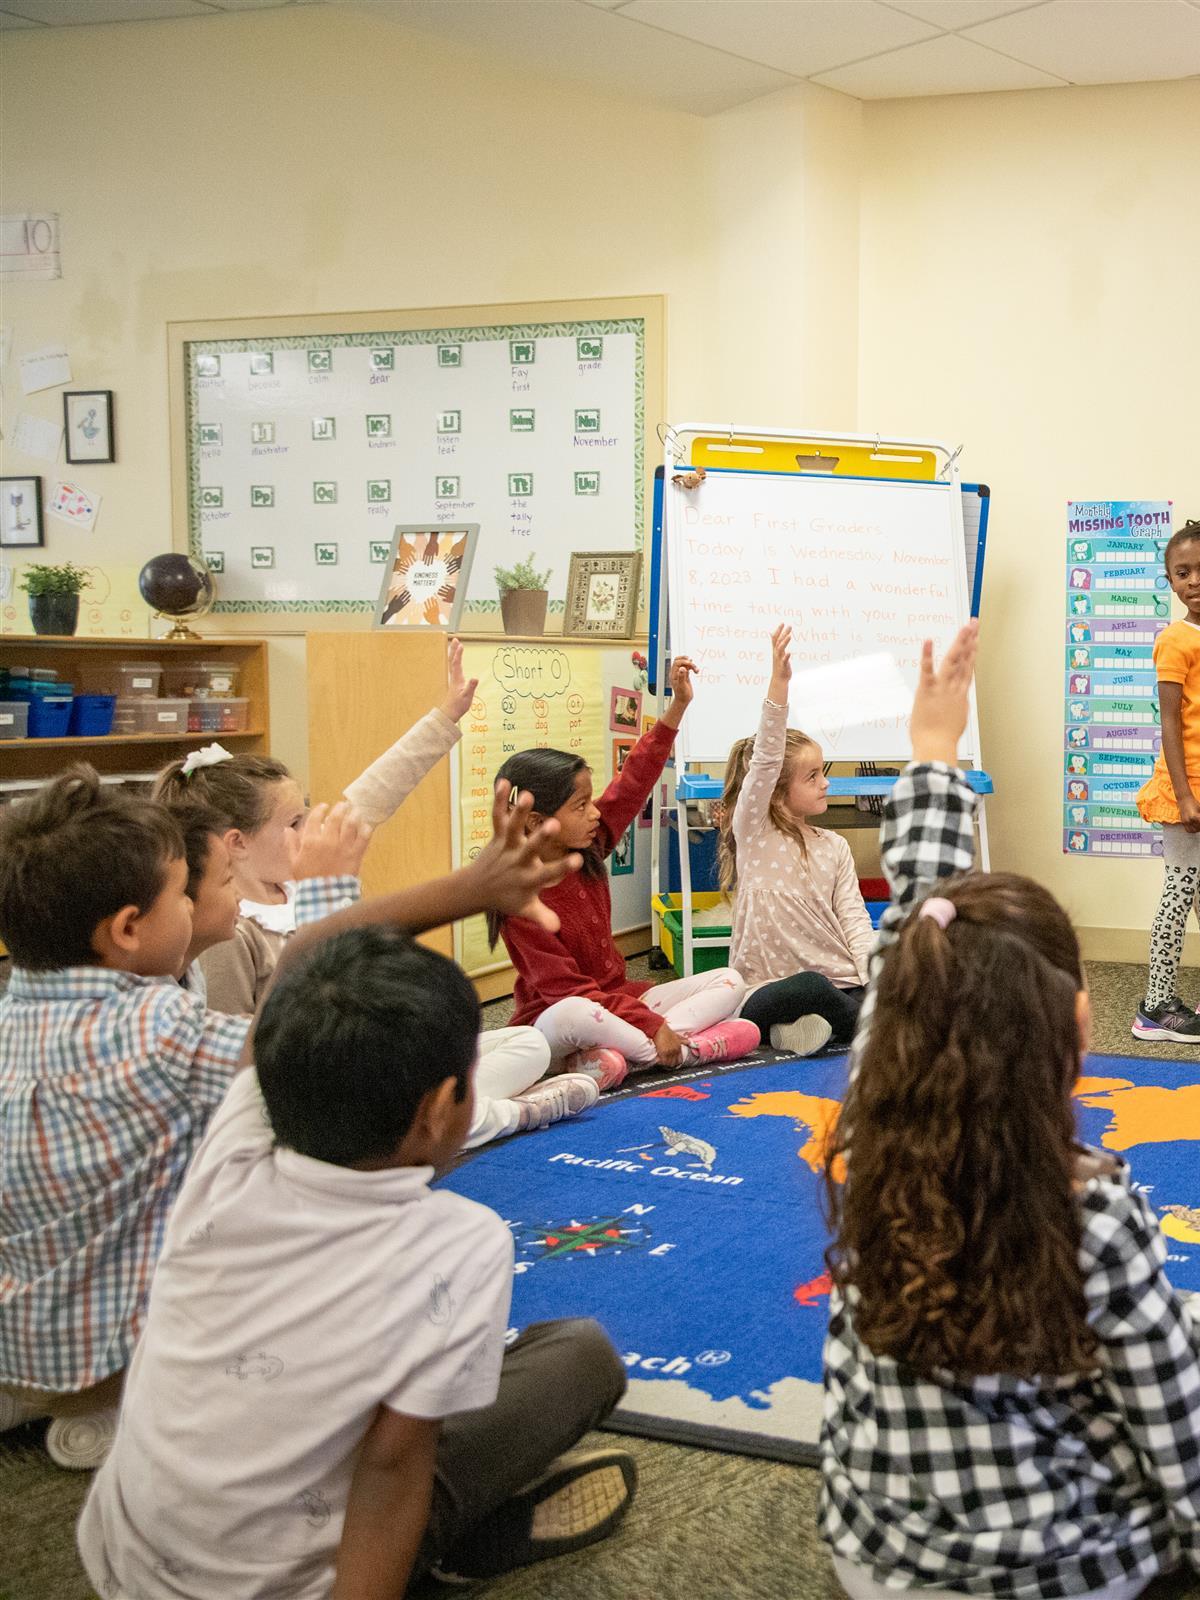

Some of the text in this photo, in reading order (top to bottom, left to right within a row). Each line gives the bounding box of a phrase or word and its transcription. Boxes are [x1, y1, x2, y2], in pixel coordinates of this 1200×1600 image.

[573, 434, 618, 448] November
[1075, 503, 1112, 518] Monthly
[684, 505, 735, 526] Dear
[753, 511, 799, 531] First
[1069, 511, 1170, 533] MISSING TOOTH
[1130, 524, 1162, 539] Graph
[1107, 540, 1145, 550] JANUARY
[685, 538, 952, 566] Today is Wednesday November
[413, 571, 439, 579] KINDNESS
[1103, 567, 1146, 578] FEBRUARY
[768, 567, 781, 585] I
[793, 569, 831, 588] had
[846, 579, 857, 591] a
[870, 580, 949, 598] wonderful
[1110, 594, 1138, 604] MARCH
[689, 598, 735, 614] time
[747, 601, 804, 625] talking
[811, 603, 850, 618] with
[1111, 621, 1137, 631] APRIL
[737, 649, 765, 662] are
[1114, 647, 1133, 657] MAY
[503, 654, 544, 680] Short
[1112, 675, 1134, 685] JUNE
[1111, 702, 1133, 711] JULY
[503, 719, 516, 731] fox
[535, 720, 549, 735] dog
[1106, 728, 1139, 738] AUGUST
[503, 741, 516, 752] box
[1098, 753, 1146, 765] SEPTEMBER
[1103, 781, 1141, 790] OCTOBER
[1100, 806, 1140, 818] NOVEMBE
[1100, 832, 1143, 841] DECEMBER
[548, 1150, 744, 1187] Pacific Ocean
[622, 1203, 656, 1216] N
[649, 1242, 677, 1257] E
[513, 1261, 536, 1275] S
